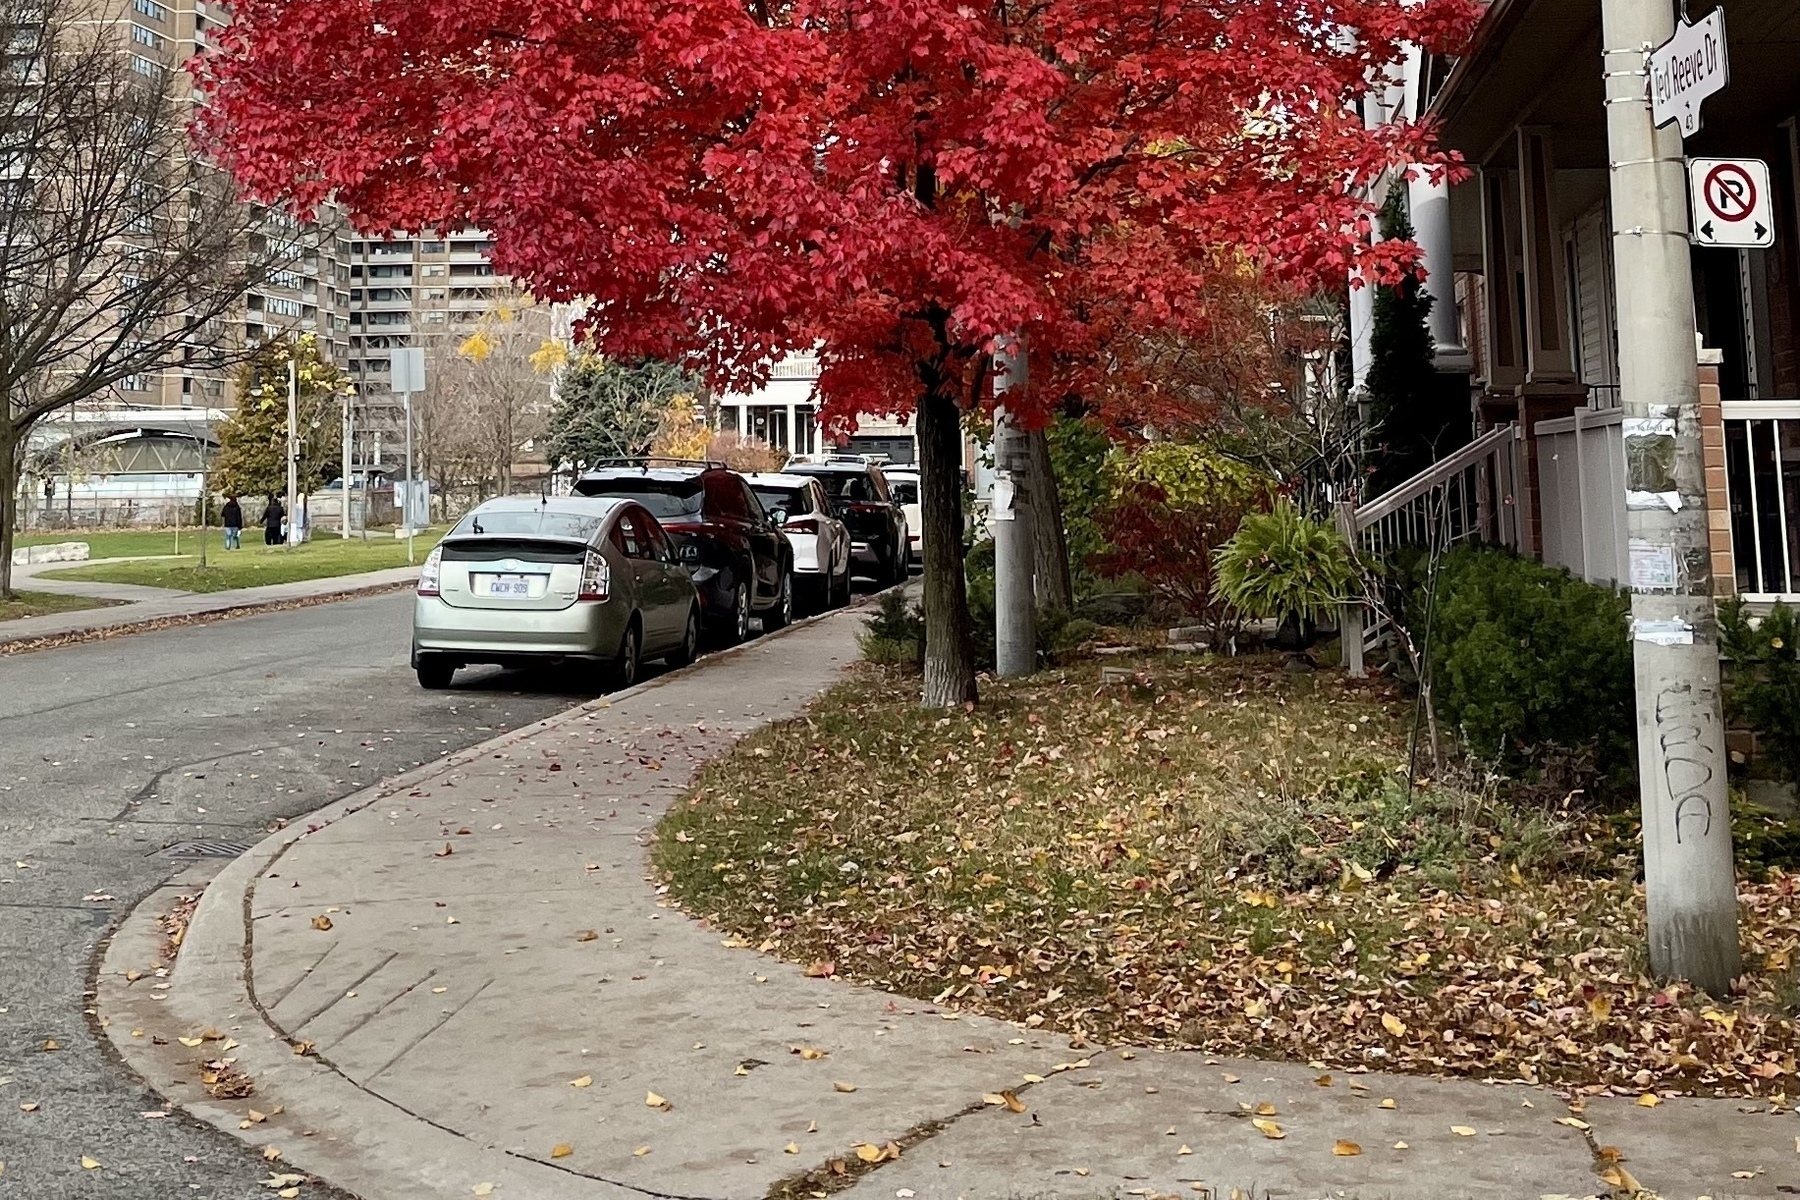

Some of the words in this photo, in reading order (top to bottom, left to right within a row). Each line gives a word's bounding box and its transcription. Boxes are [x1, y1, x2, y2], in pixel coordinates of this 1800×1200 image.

[1653, 58, 1671, 106] Ted
[1672, 49, 1704, 96] Reeve
[1704, 33, 1718, 75] Dr
